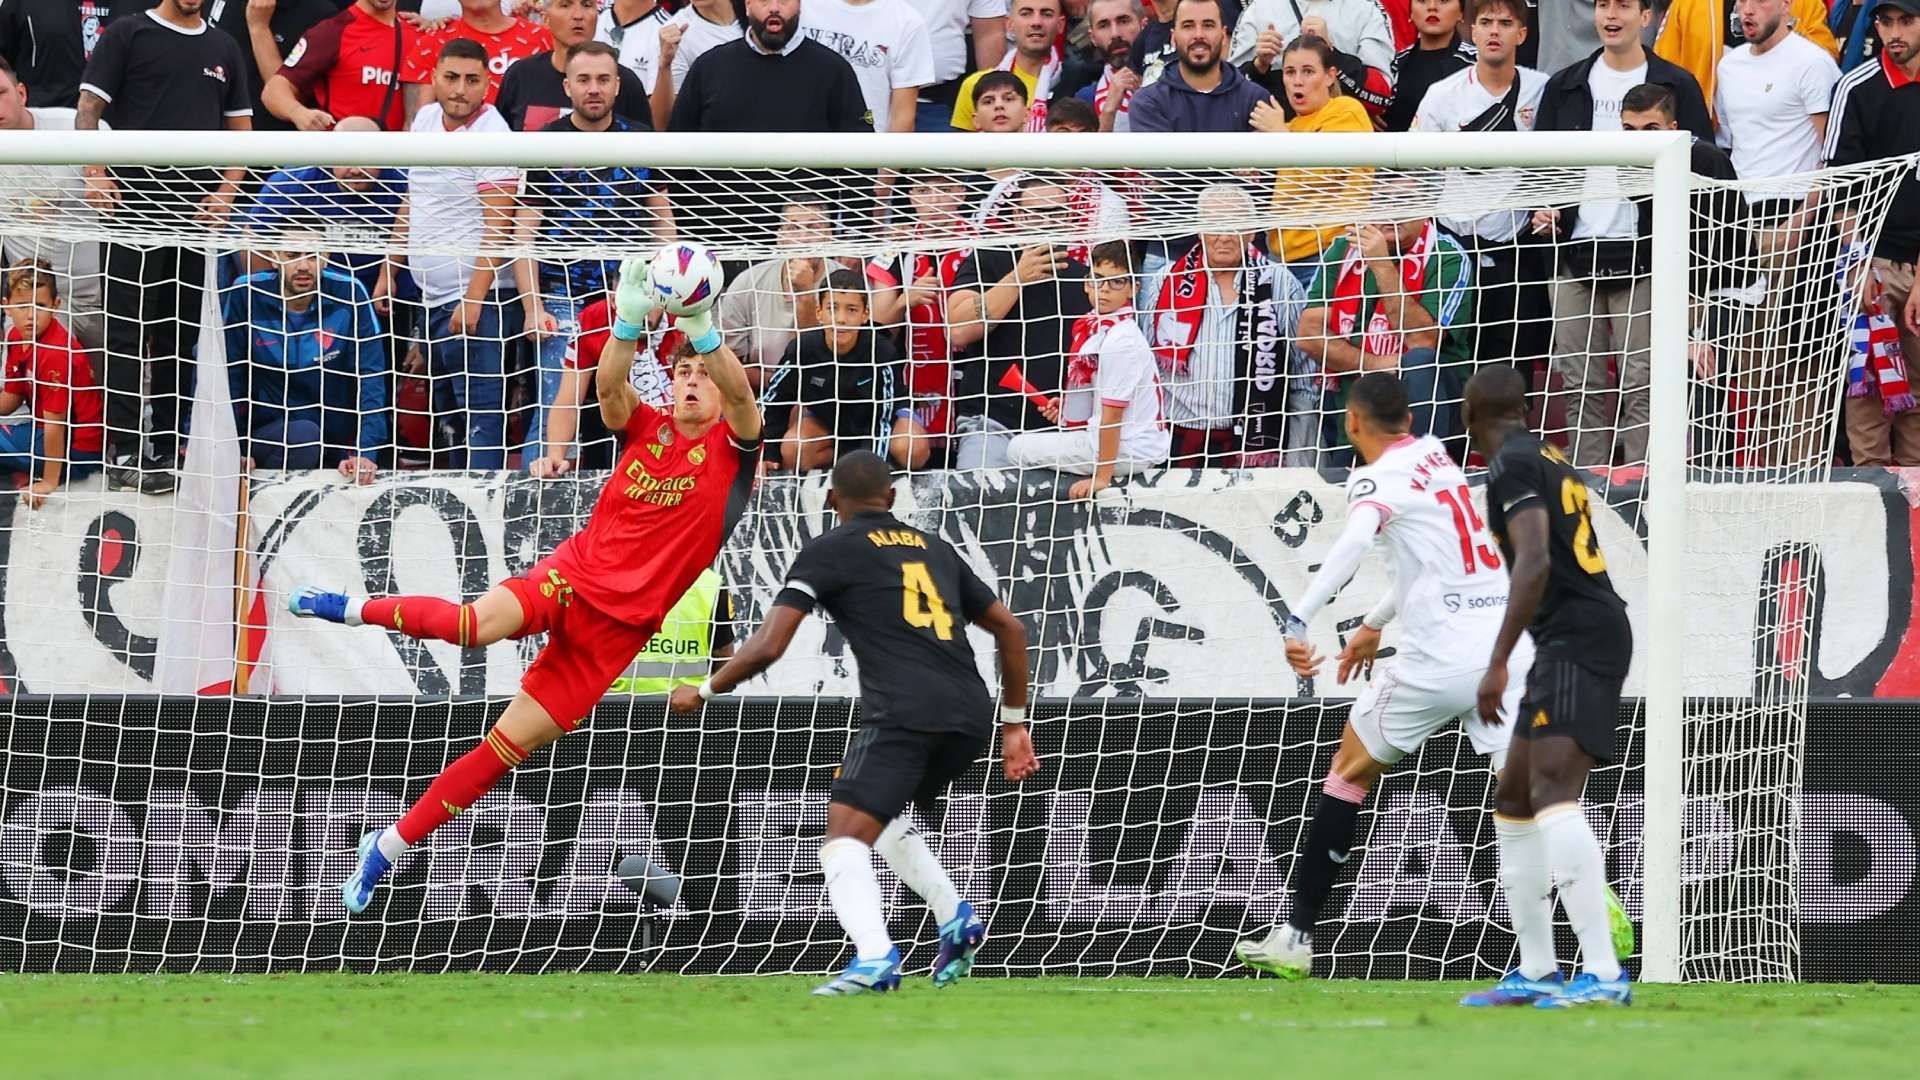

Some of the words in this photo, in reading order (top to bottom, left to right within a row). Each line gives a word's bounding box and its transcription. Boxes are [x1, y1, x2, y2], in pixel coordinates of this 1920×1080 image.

[361, 66, 400, 91] Pla
[1594, 98, 1623, 114] PO
[626, 459, 695, 491] Emirates
[624, 484, 647, 500] FLY
[643, 492, 683, 507] BETTER
[867, 530, 928, 550] ALABA
[901, 562, 953, 641] 4
[0, 786, 691, 921] OMPRA
[738, 791, 992, 922] EN
[1044, 789, 1296, 922] LA
